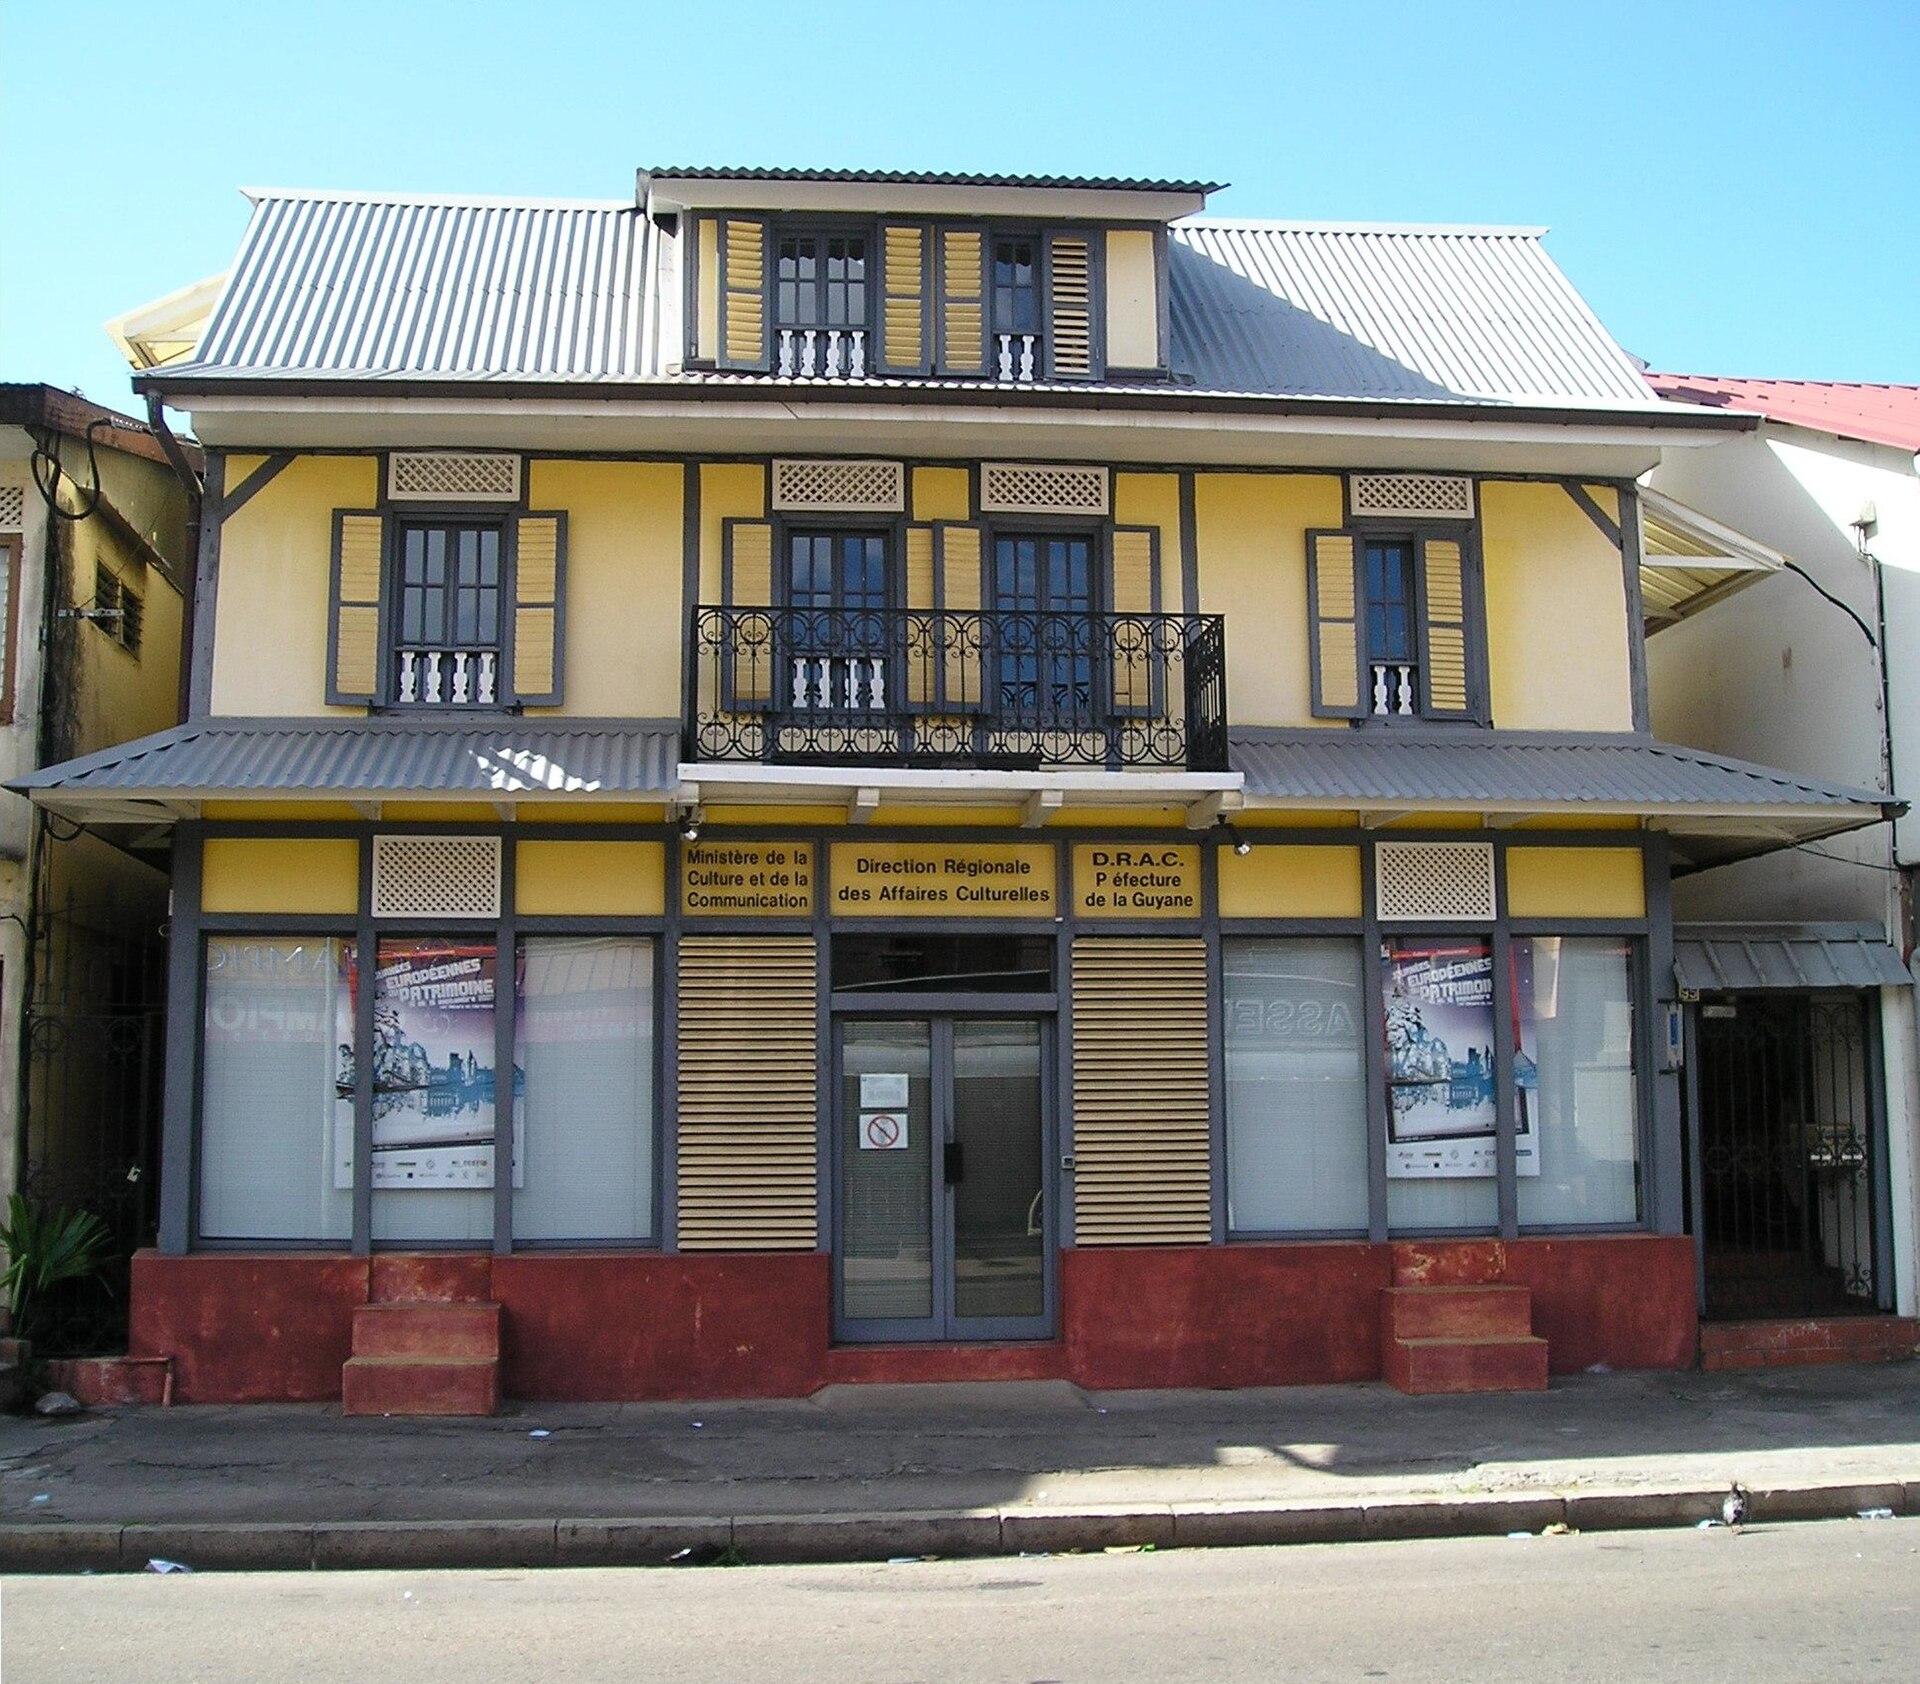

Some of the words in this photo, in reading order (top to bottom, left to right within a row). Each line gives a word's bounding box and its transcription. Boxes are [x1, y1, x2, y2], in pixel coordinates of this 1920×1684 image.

[687, 851, 759, 865] Ministère
[765, 851, 785, 865] de
[794, 851, 807, 865] la
[1092, 851, 1185, 867] D.R.A.C.
[857, 858, 937, 874] Direction
[944, 858, 1031, 877] Régionale
[687, 871, 744, 886] Culture
[749, 872, 765, 886] et
[769, 871, 789, 886] de
[795, 871, 808, 886] la
[687, 892, 808, 908] Communication
[838, 886, 871, 901] des
[879, 886, 948, 901] Affaires
[956, 885, 1050, 902] Culturelles
[1085, 892, 1106, 907] de
[1113, 892, 1127, 907] la
[1132, 891, 1194, 910] Guyane
